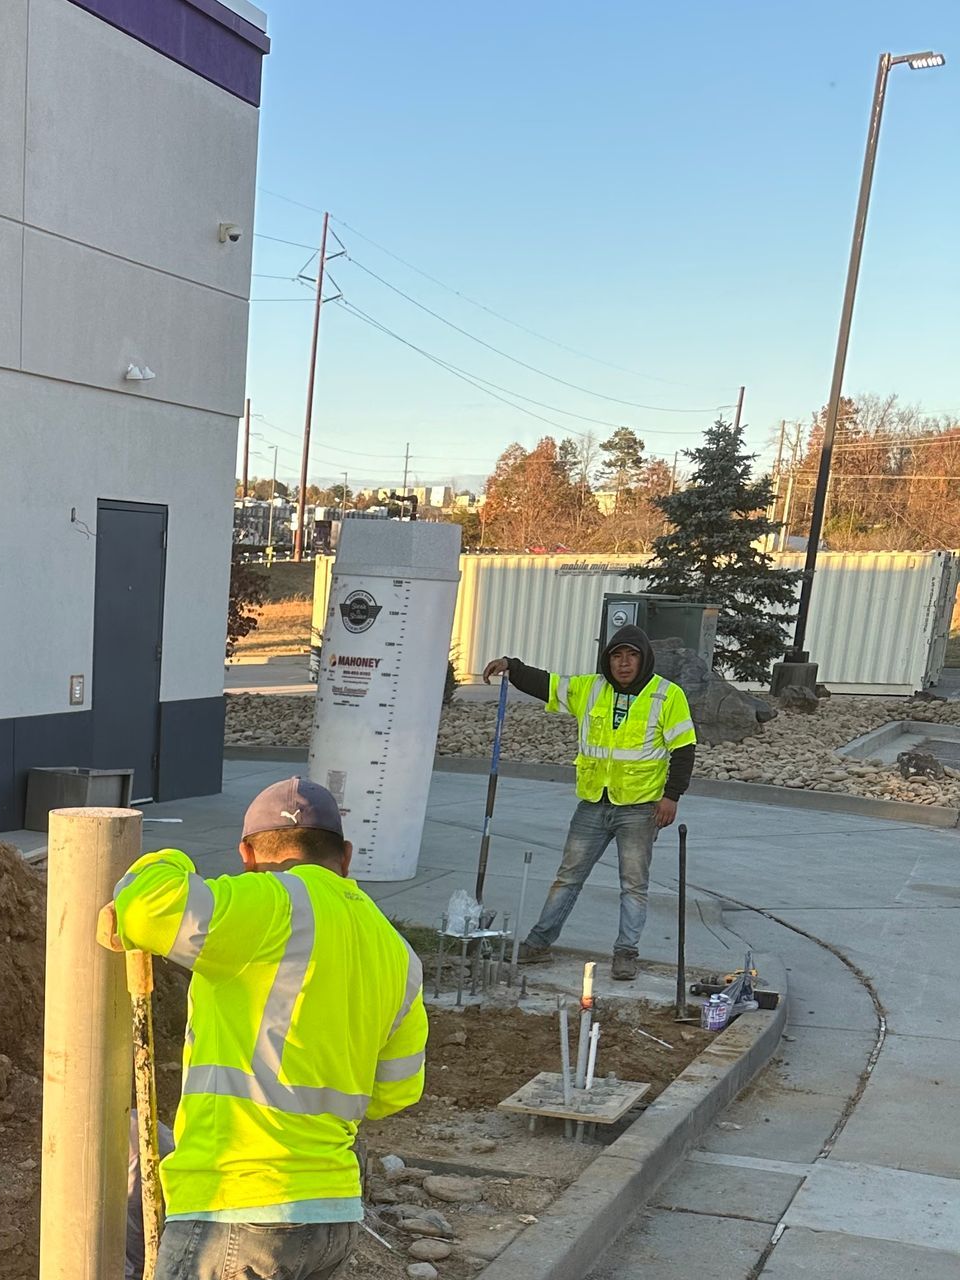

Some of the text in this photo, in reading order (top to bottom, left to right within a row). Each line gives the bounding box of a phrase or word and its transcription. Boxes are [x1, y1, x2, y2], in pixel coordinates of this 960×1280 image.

[560, 559, 589, 570] mobile
[589, 561, 609, 570] mini
[338, 655, 381, 668] MAHONEY
